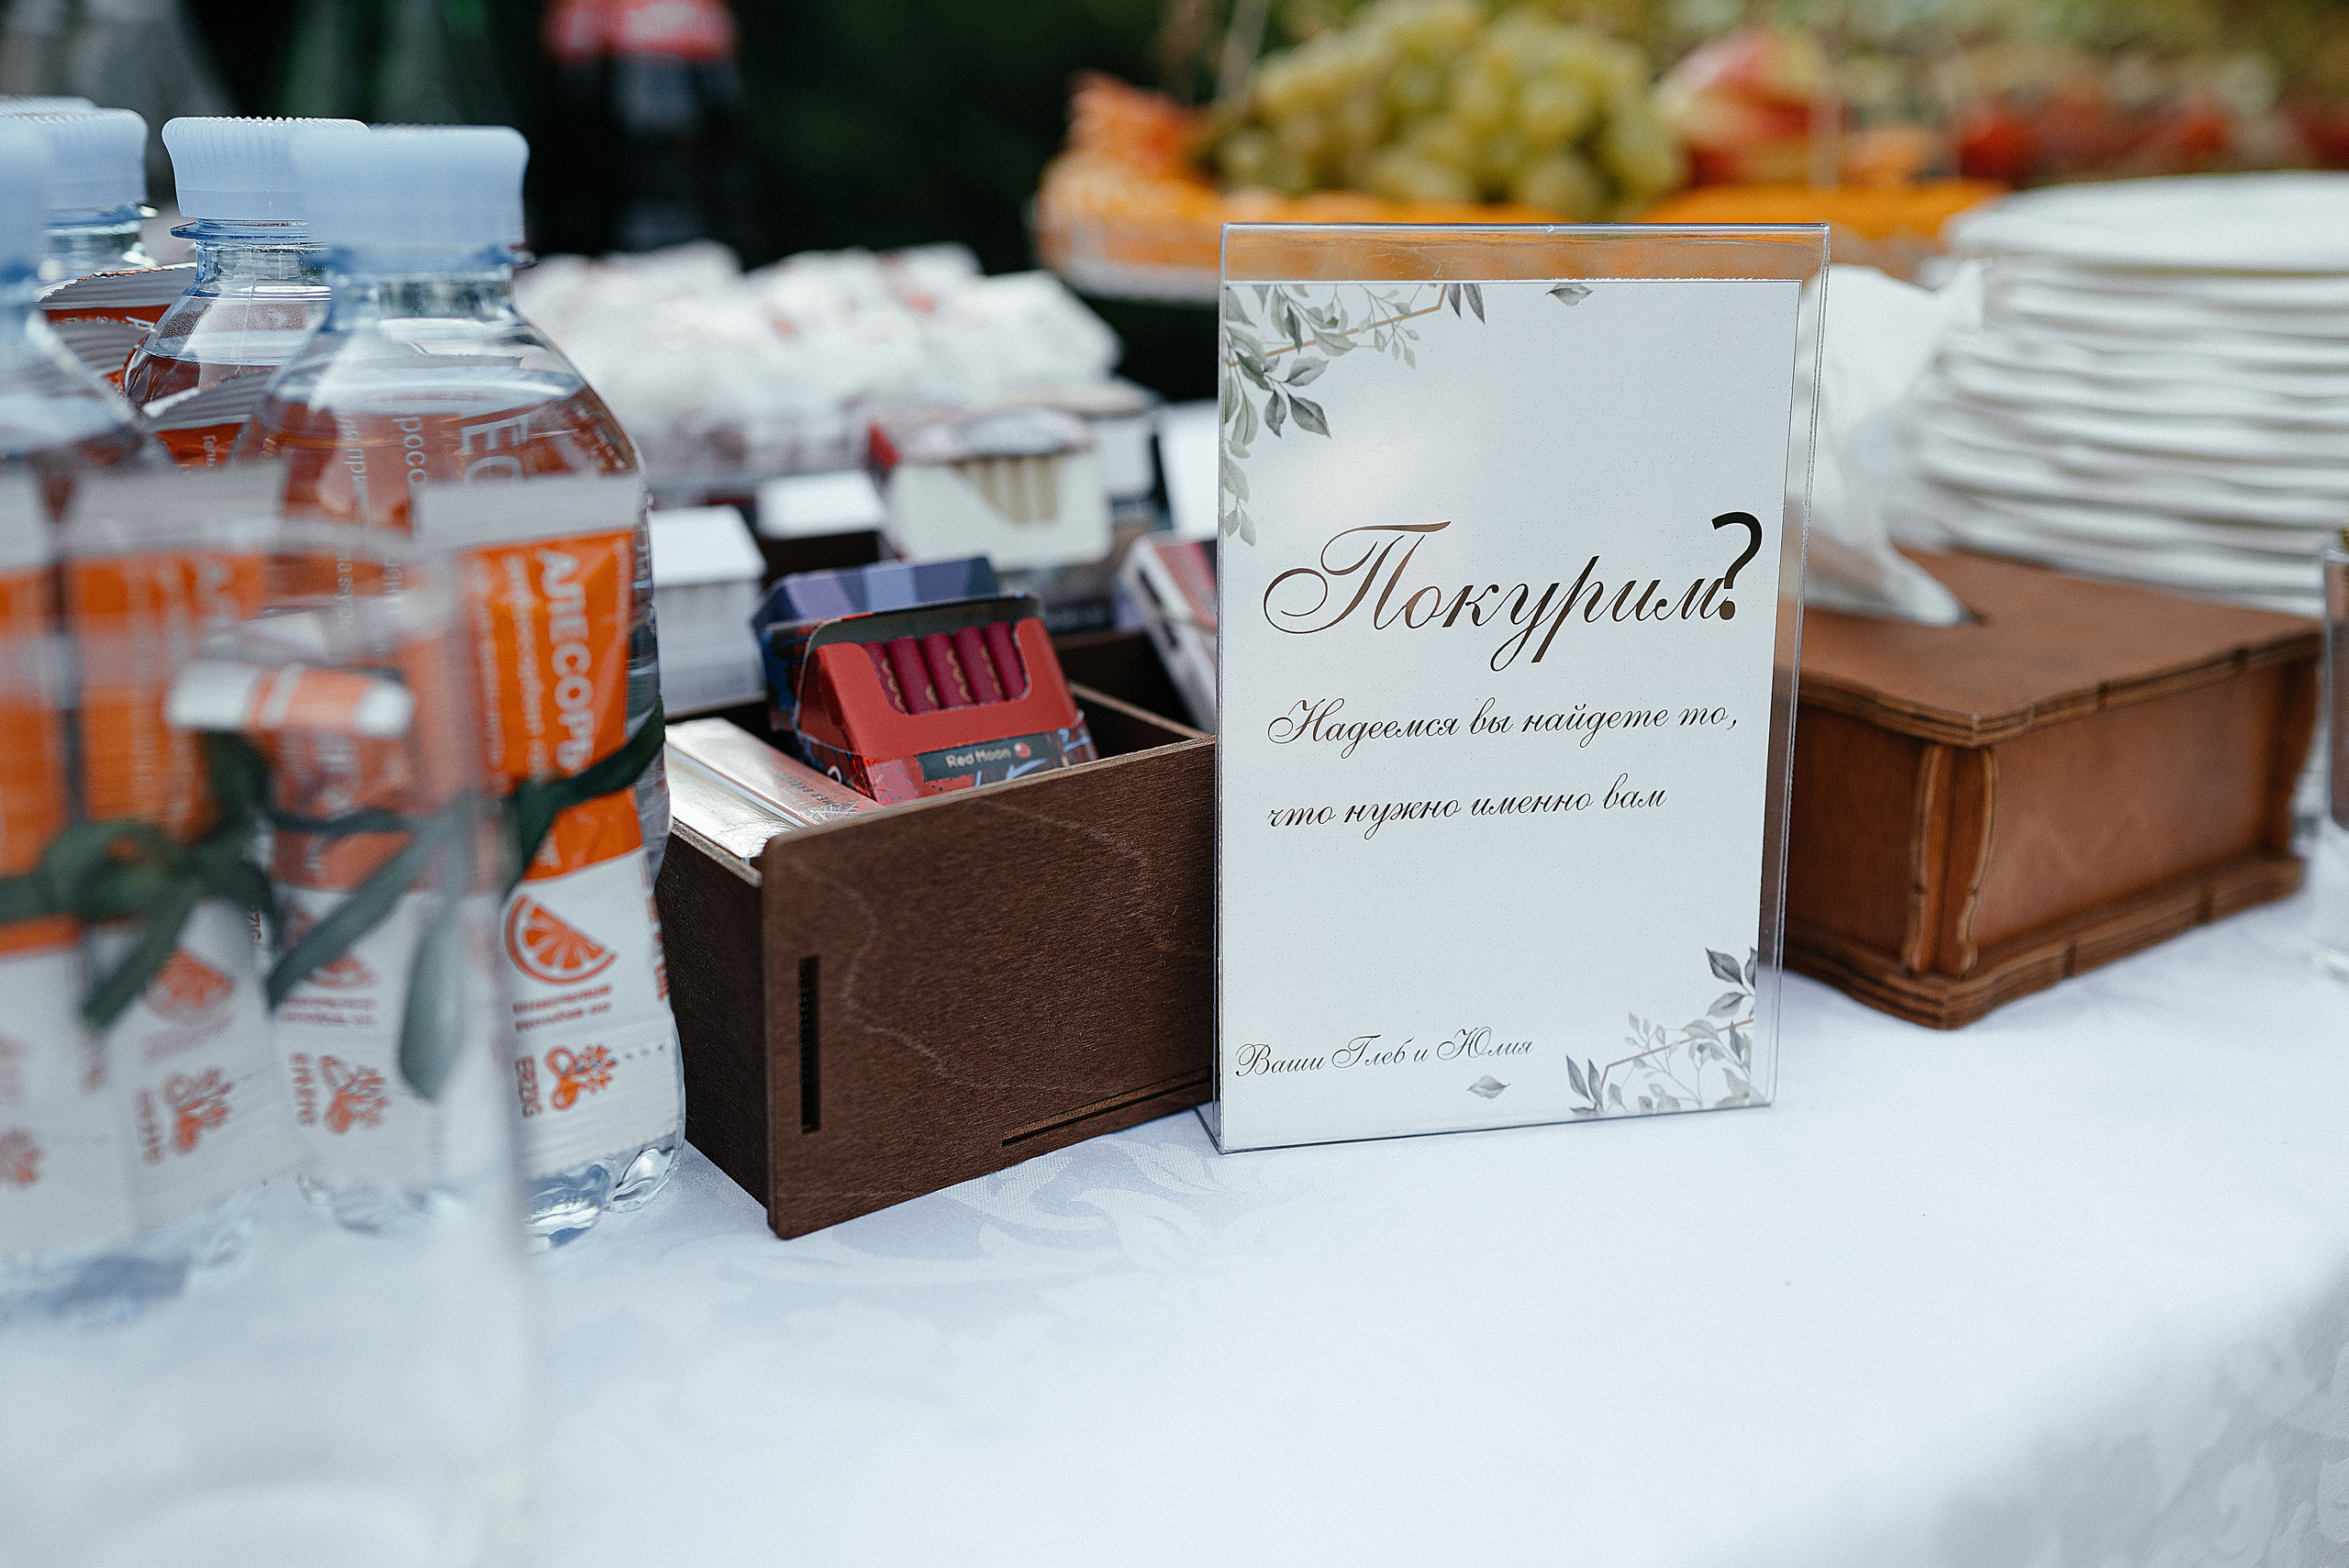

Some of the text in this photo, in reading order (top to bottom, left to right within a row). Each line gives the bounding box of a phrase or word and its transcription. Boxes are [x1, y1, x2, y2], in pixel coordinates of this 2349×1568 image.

[1264, 512, 1762, 672] Покурим?
[944, 746, 1013, 769] Red Moon
[1268, 697, 1736, 759] Надеемся вы найдете то,
[1267, 773, 1667, 840] что нужно именно вам
[1235, 1027, 1532, 1076] Ваши Глеб и Юлия
